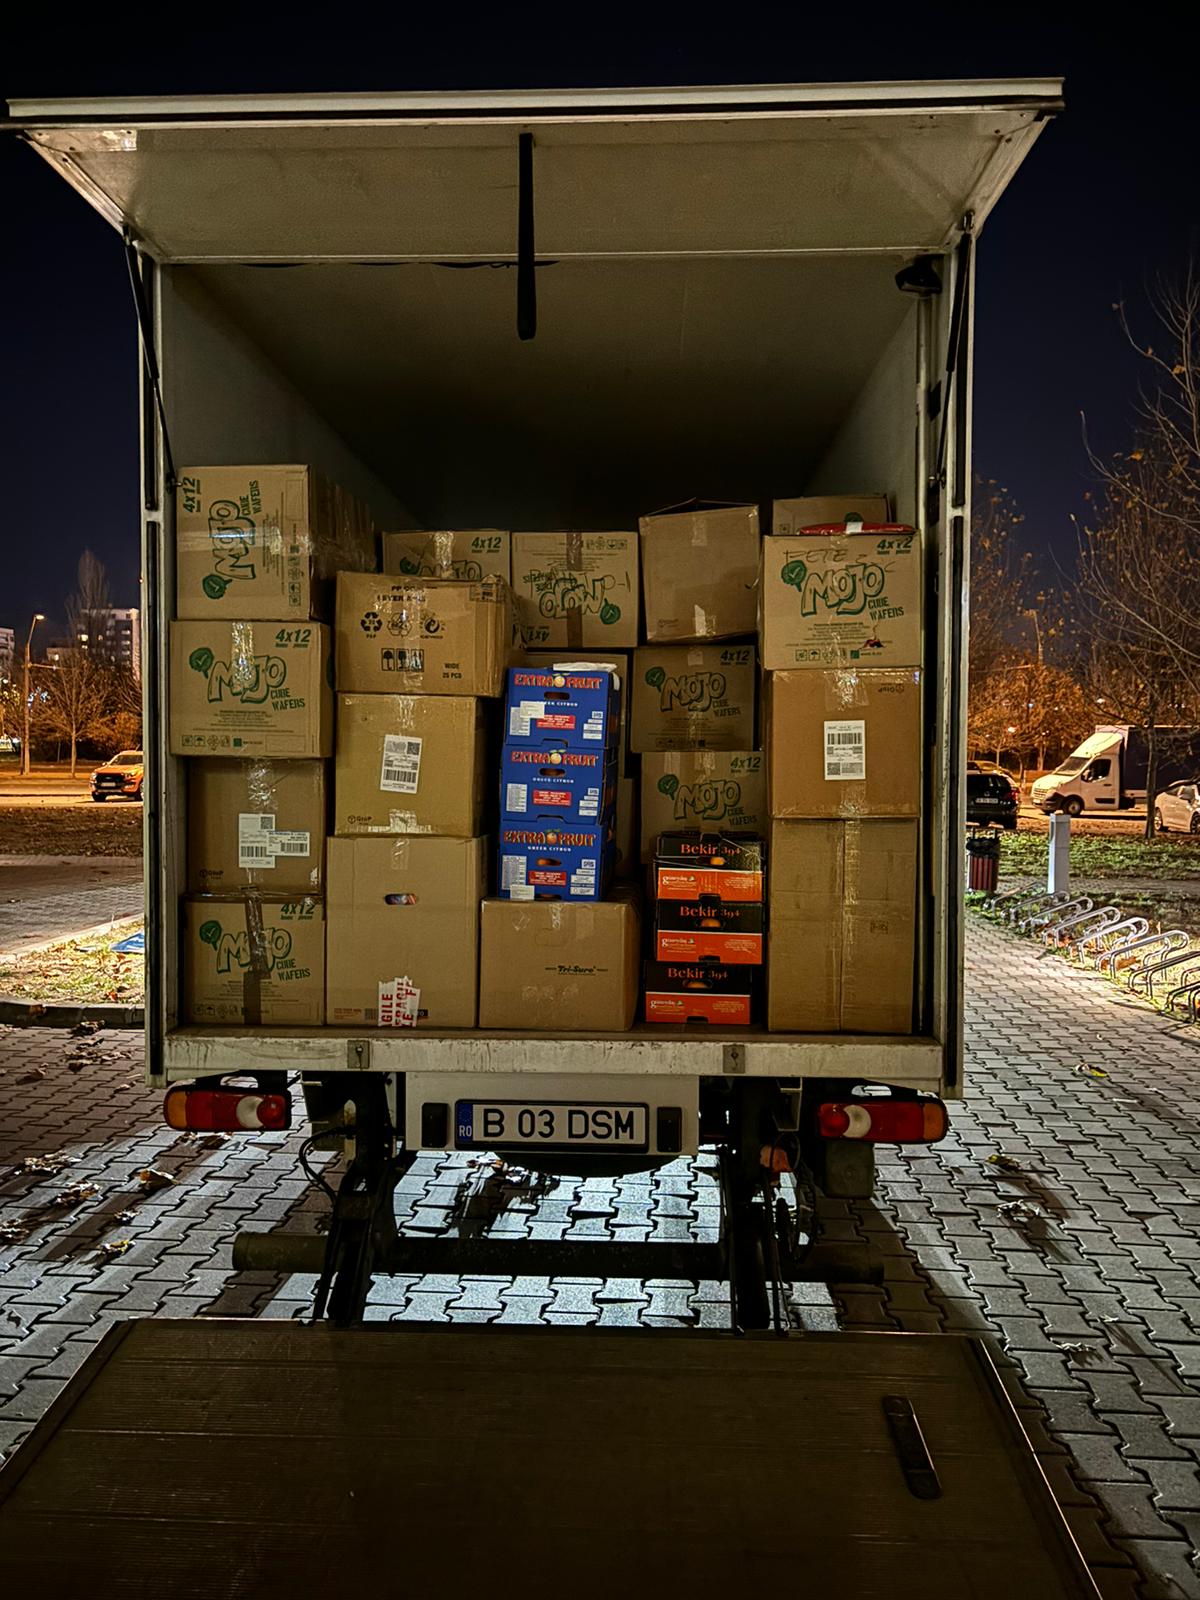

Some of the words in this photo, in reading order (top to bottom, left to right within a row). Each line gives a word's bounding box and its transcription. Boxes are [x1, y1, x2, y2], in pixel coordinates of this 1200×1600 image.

[183, 477, 197, 513] 4x12
[471, 537, 502, 549] 4x12
[877, 536, 914, 549] 4x12
[801, 563, 885, 617] MOJO
[870, 606, 905, 621] WAFERS
[275, 629, 311, 643] 4x12
[720, 650, 750, 661] 4x12
[514, 674, 553, 688] EXTRA
[565, 677, 602, 689] FRUIT
[660, 672, 726, 712] MOJO
[272, 699, 306, 712] WAFERS
[511, 751, 550, 764] EXTRA
[562, 754, 598, 767] FRUIT
[730, 757, 761, 768] 4x12
[674, 780, 741, 820] MOJO
[503, 831, 545, 844] EXTRA
[557, 833, 596, 847] FRUIT
[681, 843, 718, 855] Bekir
[281, 903, 315, 915] 4x12
[680, 906, 717, 917] Bekir
[668, 967, 705, 979] Bekir
[482, 1108, 505, 1137] B
[518, 1109, 555, 1138] 03
[567, 1109, 634, 1140] DSM
[458, 1125, 472, 1137] RO
